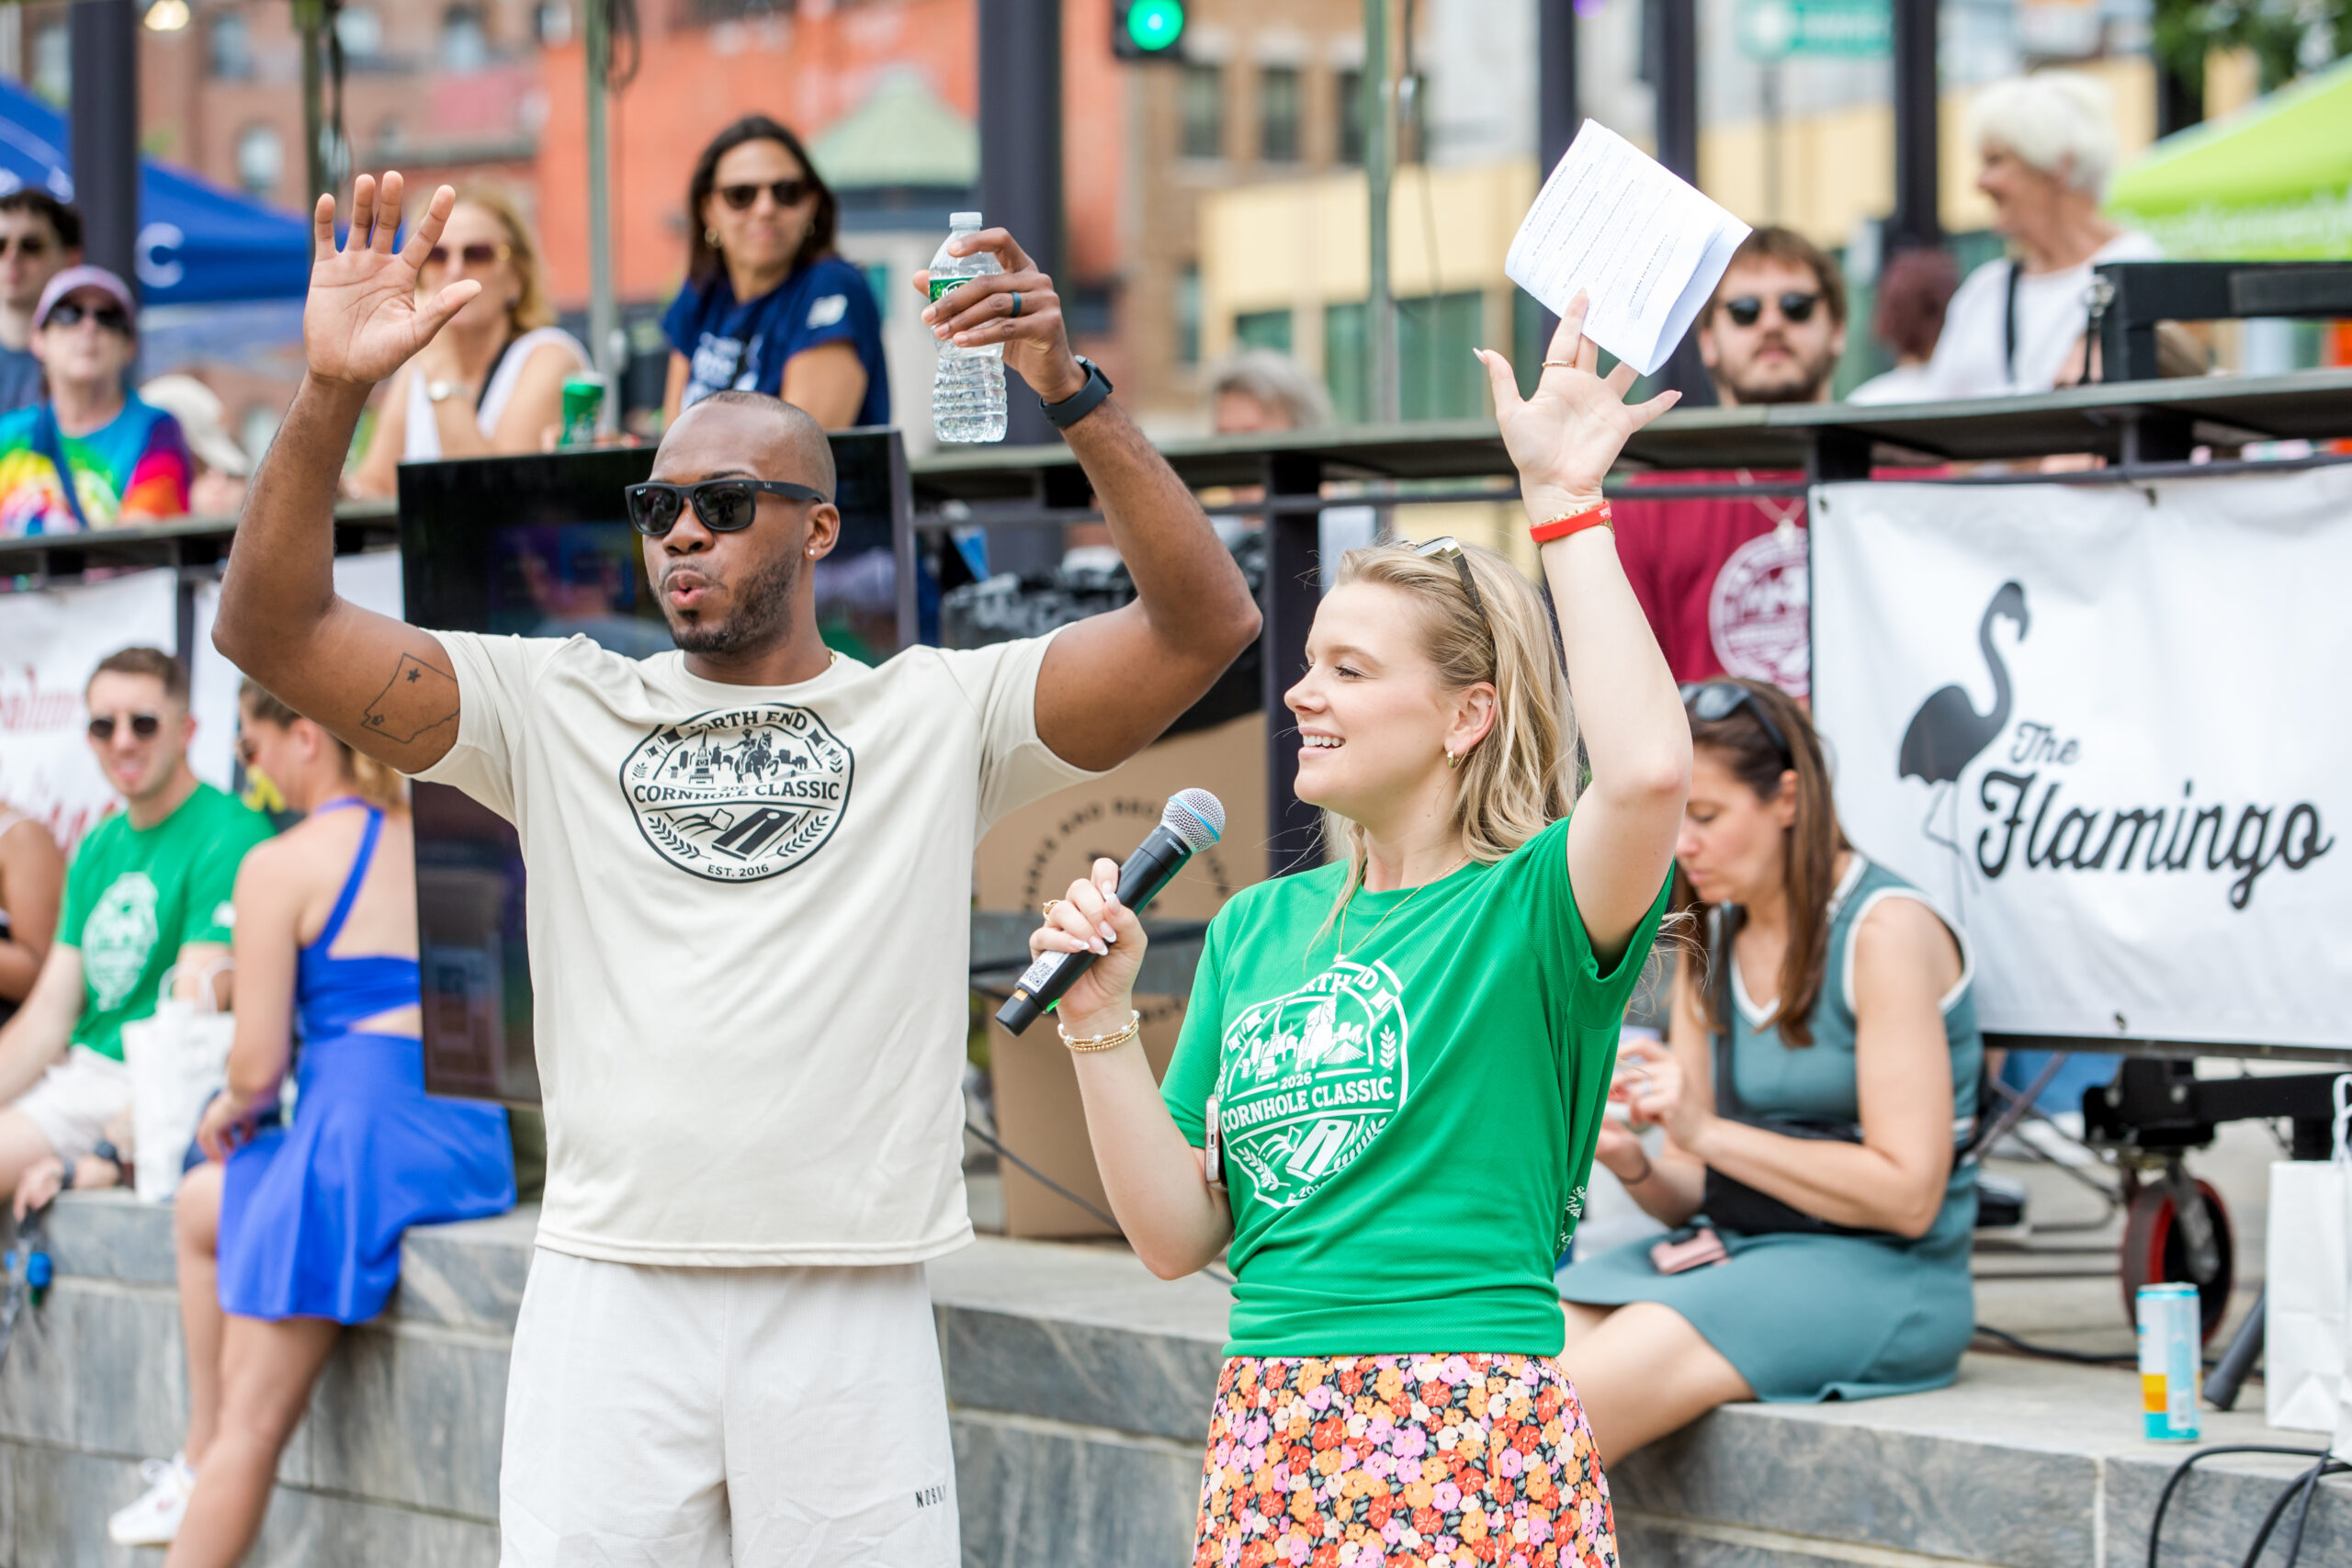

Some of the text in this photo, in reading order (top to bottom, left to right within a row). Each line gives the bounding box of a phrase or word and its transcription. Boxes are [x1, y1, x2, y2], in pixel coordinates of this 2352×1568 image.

[765, 711, 808, 730] END
[2010, 720, 2081, 765] The
[633, 780, 840, 804] CORNHOLE CLASSIC
[1977, 770, 2336, 911] Flamingo
[707, 863, 769, 878] EST. 2016
[1280, 1071, 1312, 1090] 2026
[1221, 1076, 1395, 1134] CORNHOLE CLASSIC
